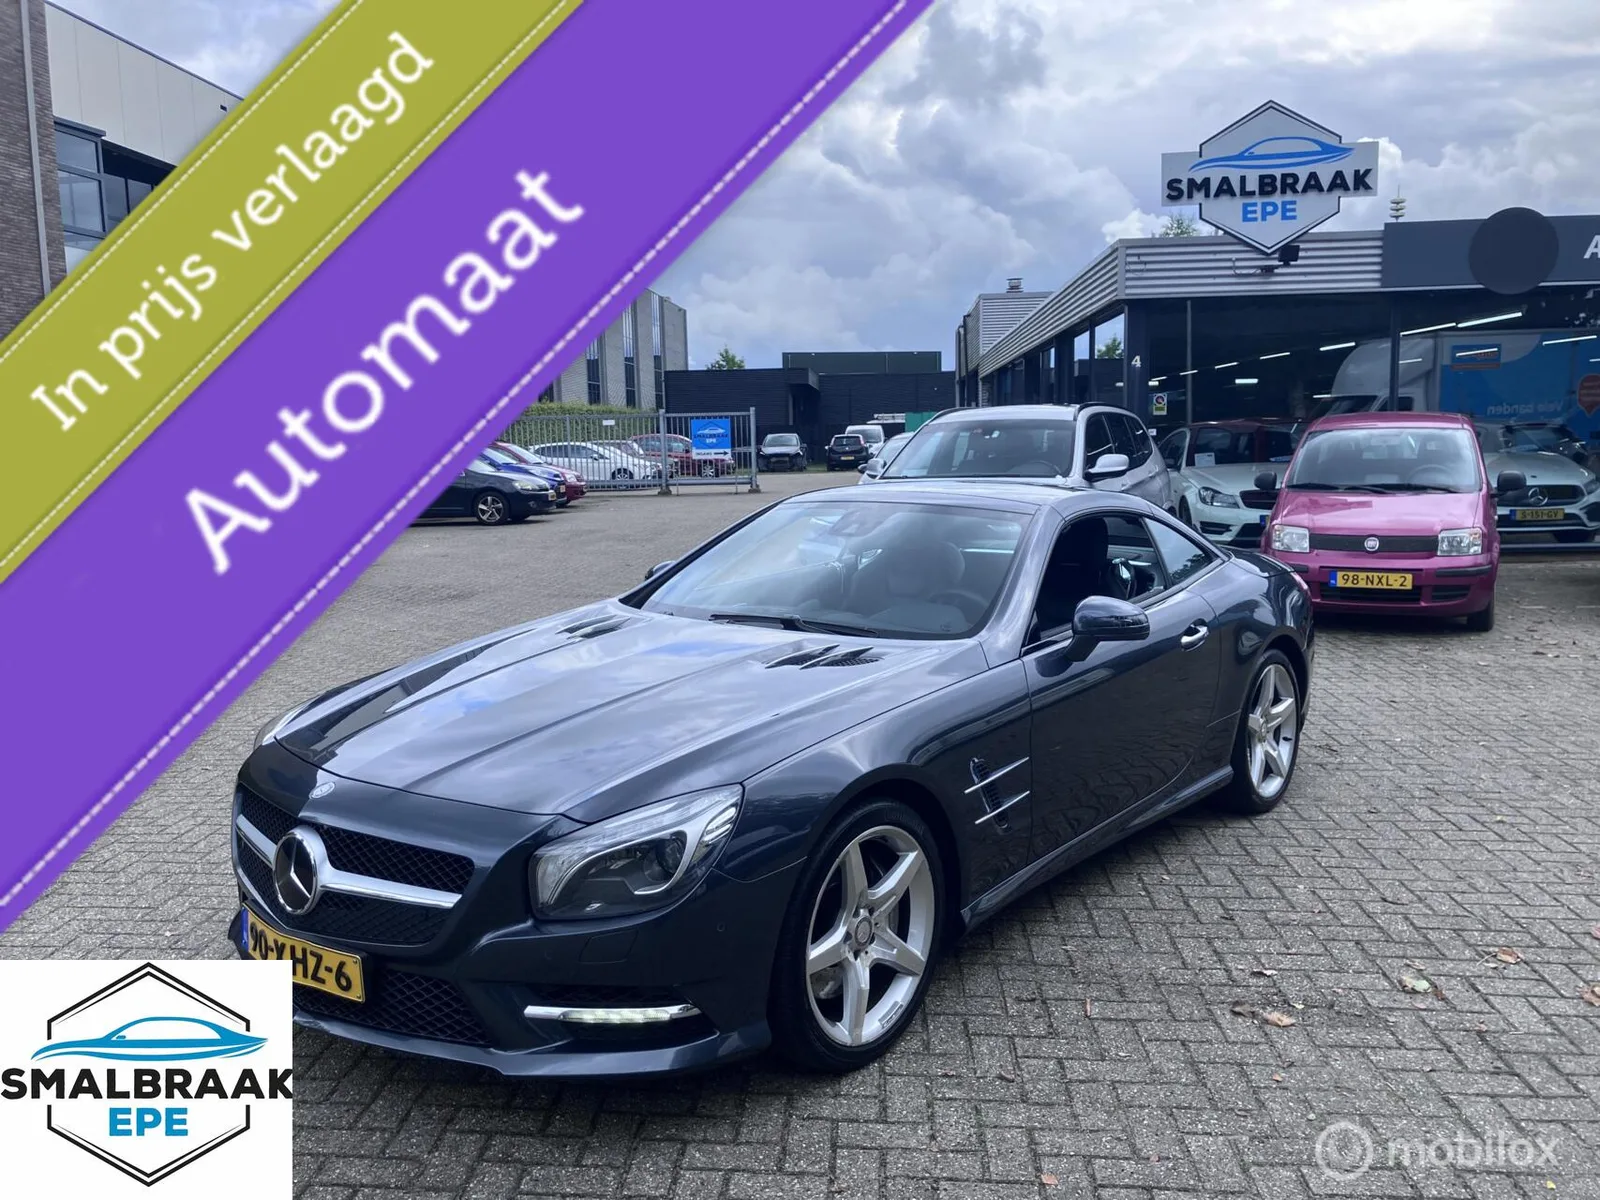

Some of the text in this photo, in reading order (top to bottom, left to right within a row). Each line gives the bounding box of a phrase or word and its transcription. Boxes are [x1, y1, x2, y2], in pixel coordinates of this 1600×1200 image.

[1166, 168, 1373, 201] SMALBRAAK
[1242, 201, 1298, 222] EPE
[1131, 355, 1142, 368] 4
[1341, 573, 1408, 588] 98-NXL-2
